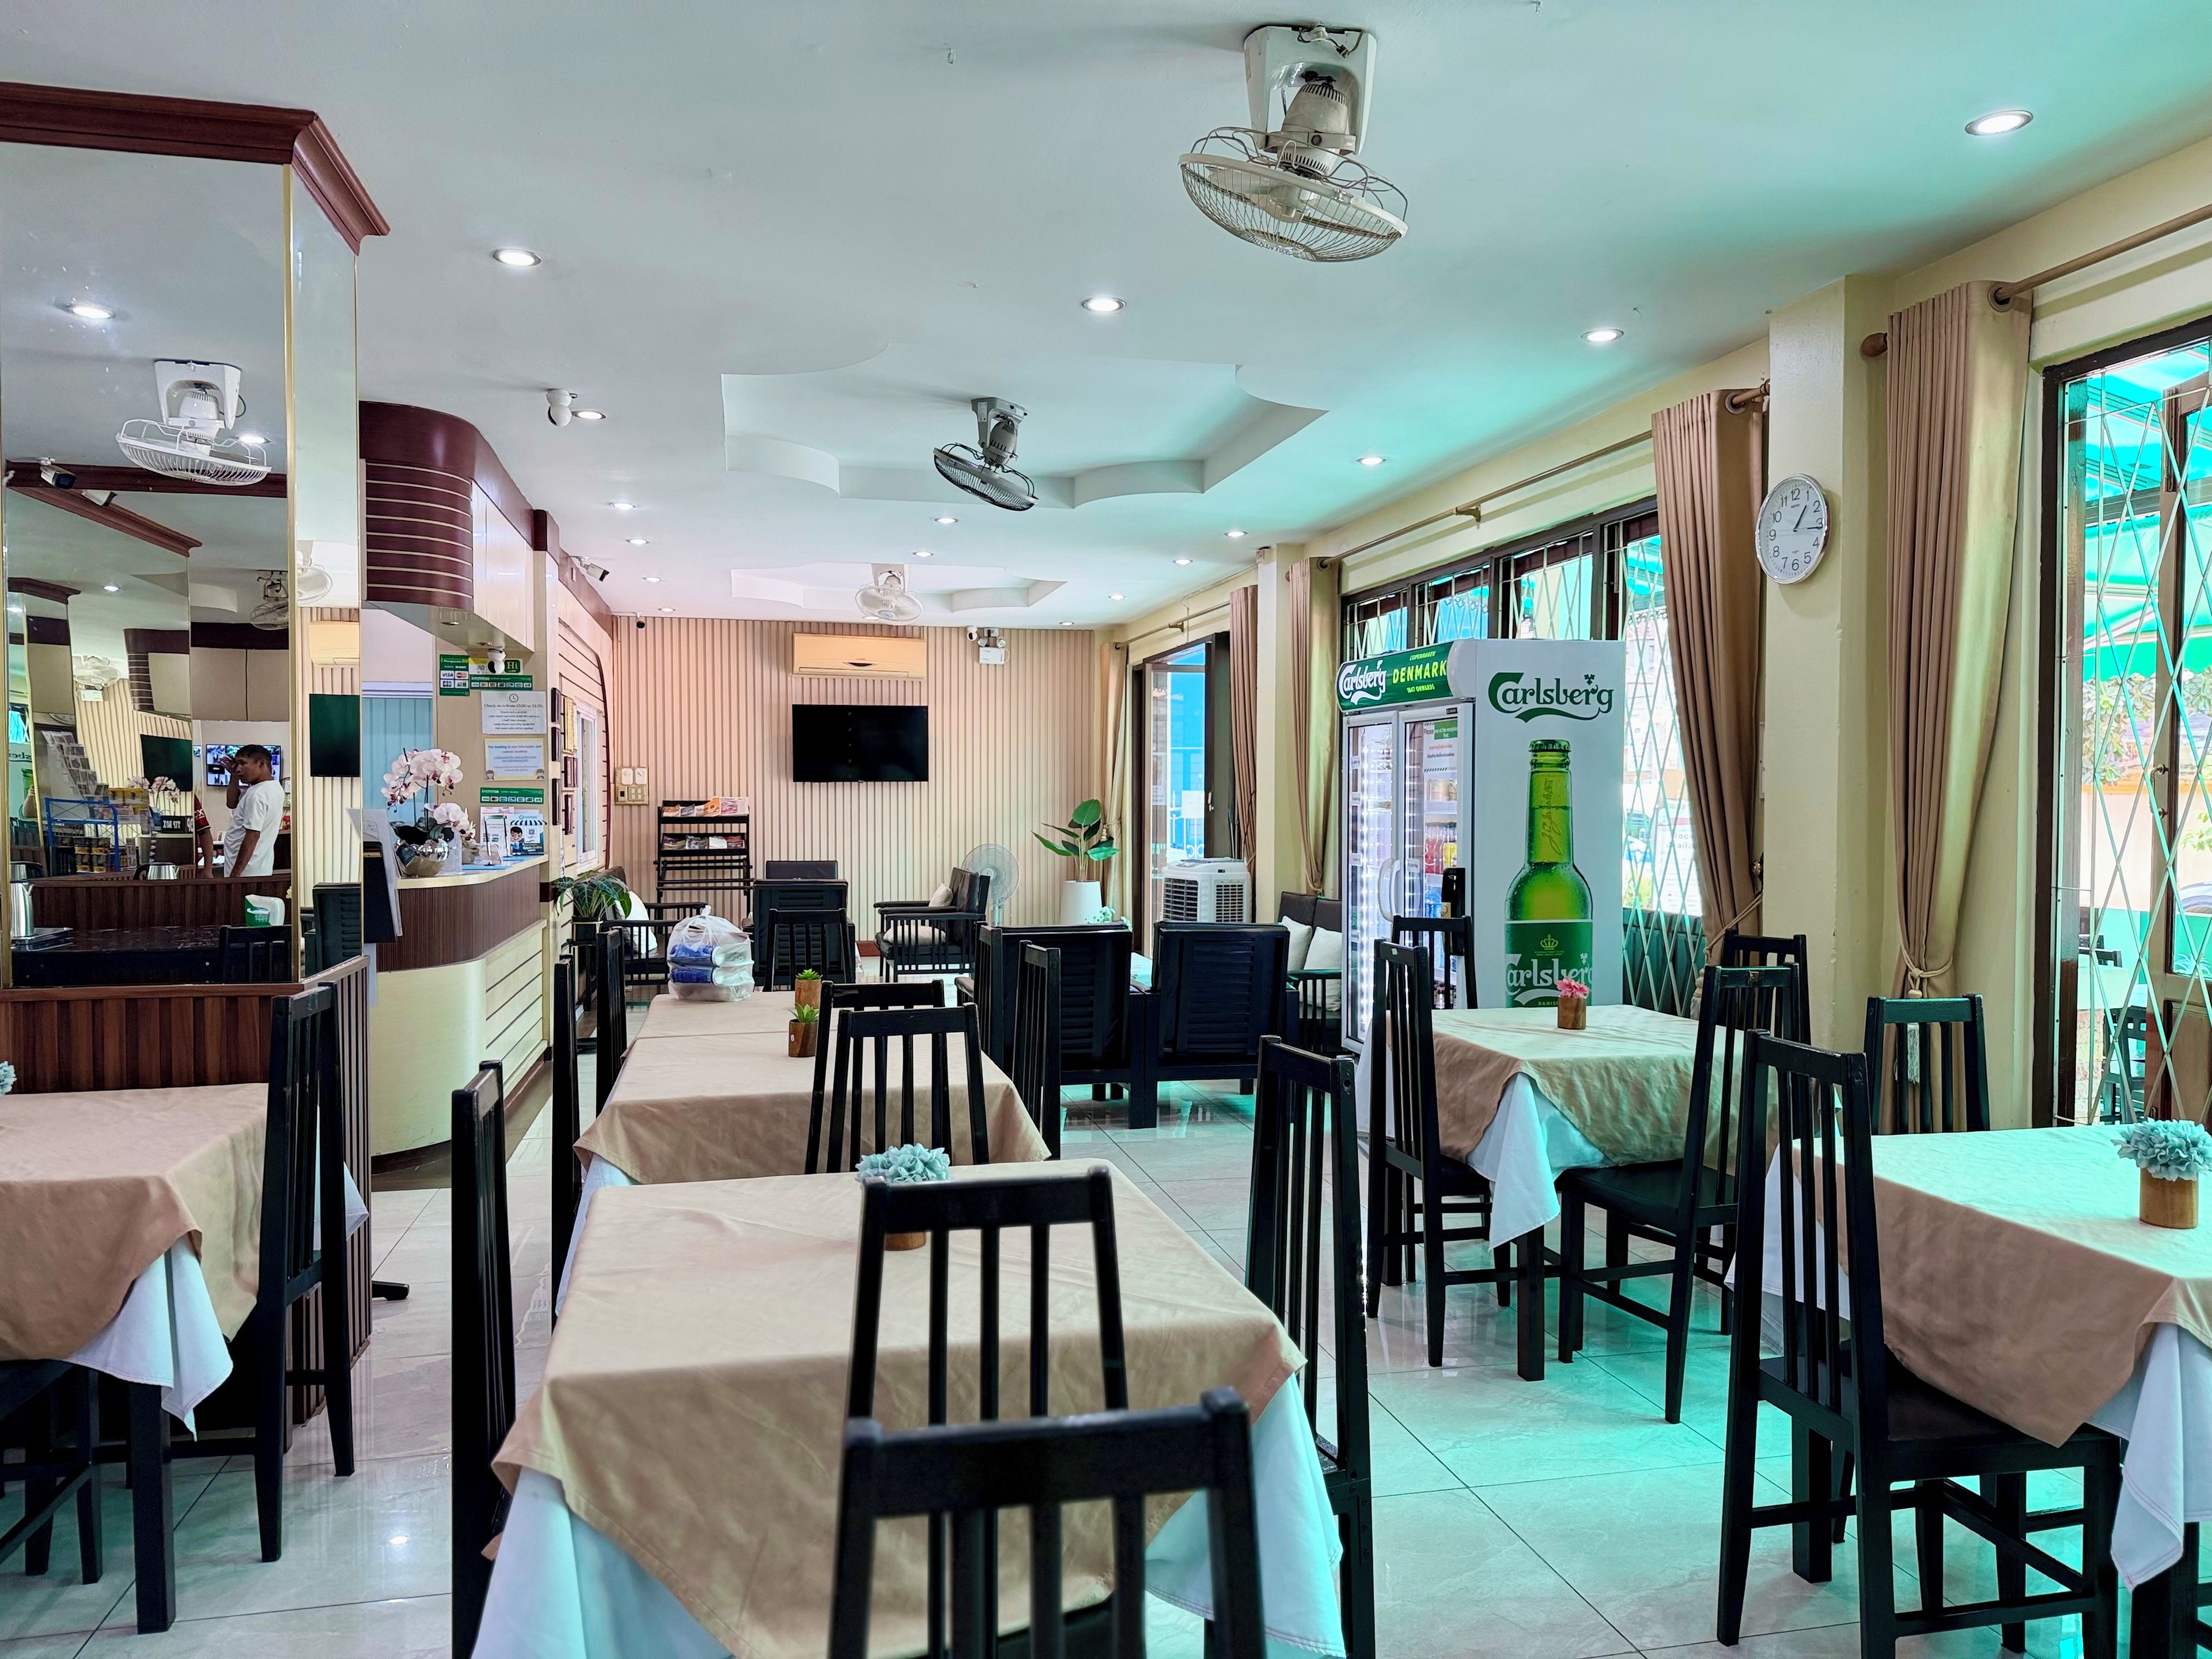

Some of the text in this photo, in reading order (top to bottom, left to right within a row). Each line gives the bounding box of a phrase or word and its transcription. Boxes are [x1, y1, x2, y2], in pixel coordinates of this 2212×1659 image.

[1791, 488, 1800, 501] 12
[1806, 490, 1809, 501] 1
[1781, 495, 1787, 507] 11
[1813, 500, 1820, 513] 2
[1772, 511, 1782, 522] 10
[1816, 518, 1823, 529] 3
[1769, 529, 1776, 541] 9
[1813, 537, 1820, 548] 4
[1773, 546, 1779, 558] 8
[1804, 552, 1811, 564] 5
[1782, 557, 1788, 569] 7
[1791, 559, 1799, 571] 6
[1409, 651, 1436, 661] COPENHAGEN
[1392, 660, 1447, 684] DENMARK
[1339, 662, 1387, 700] Carlsberg
[1488, 672, 1614, 714] Carlsberg
